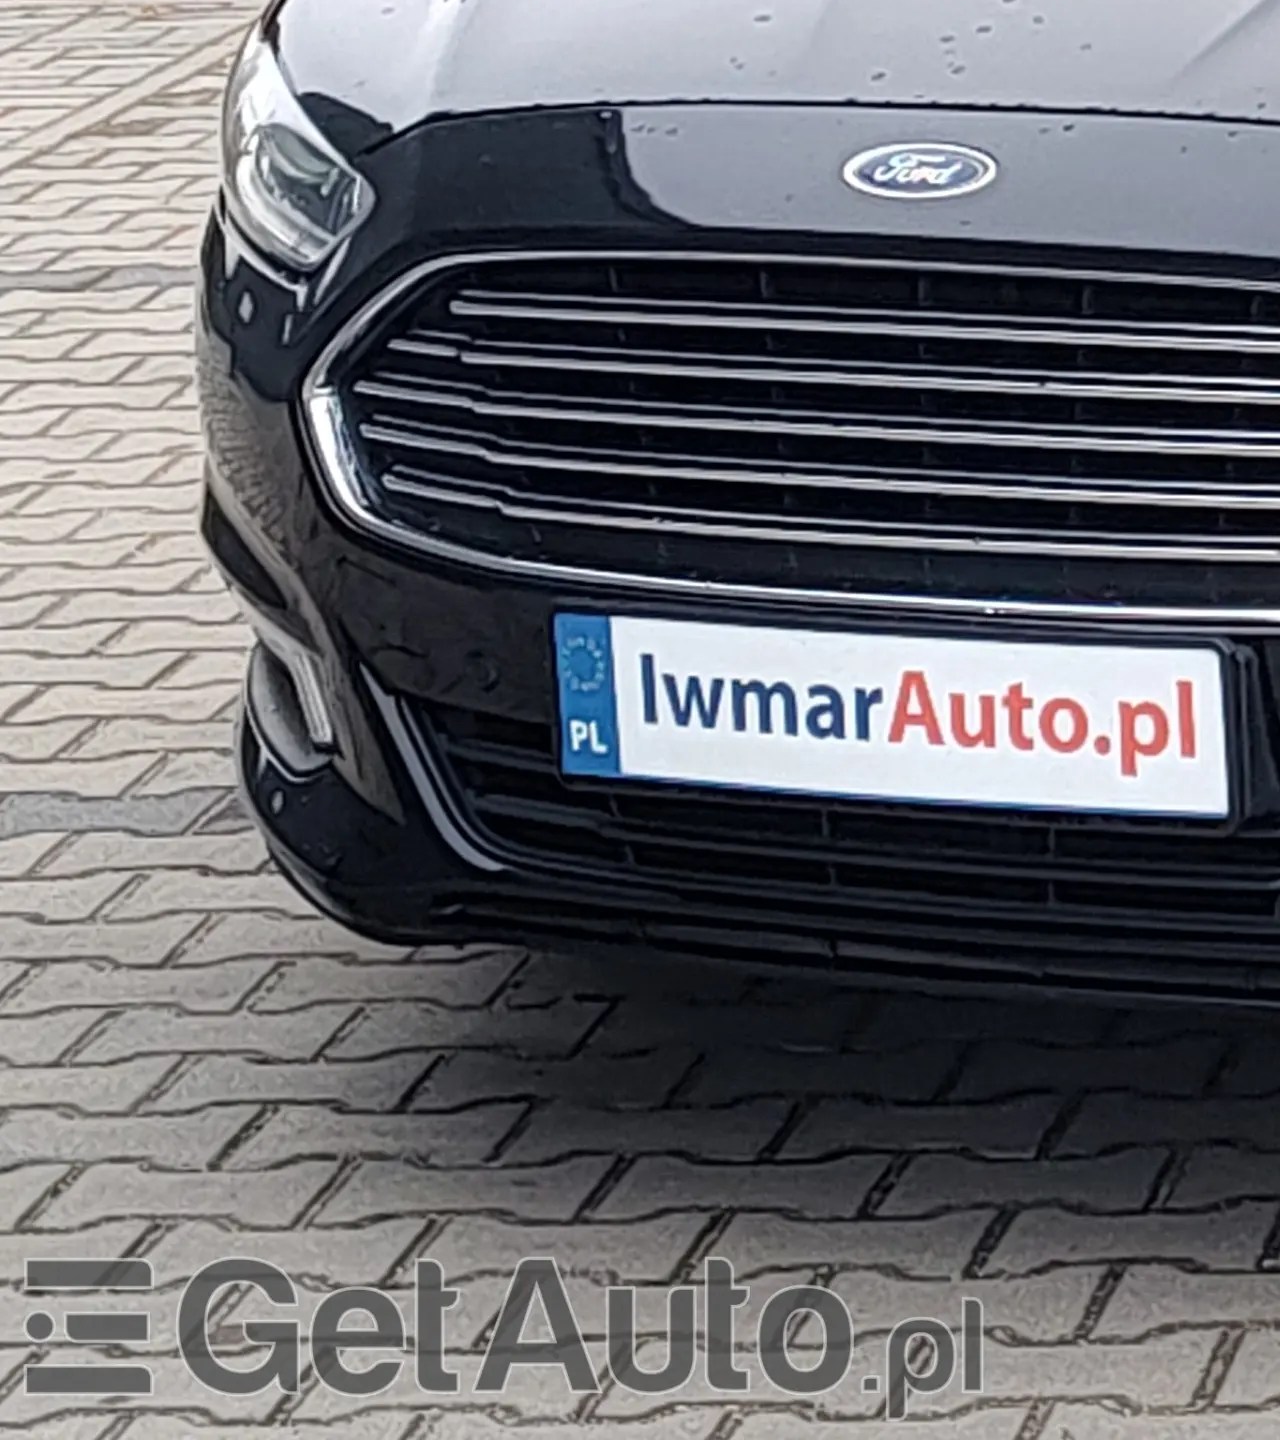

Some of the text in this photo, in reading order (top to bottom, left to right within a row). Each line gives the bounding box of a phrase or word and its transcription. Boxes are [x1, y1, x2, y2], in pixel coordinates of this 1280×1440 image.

[872, 152, 963, 185] Ford
[638, 652, 1197, 778] IwmarAuto.pl
[569, 718, 608, 754] PL
